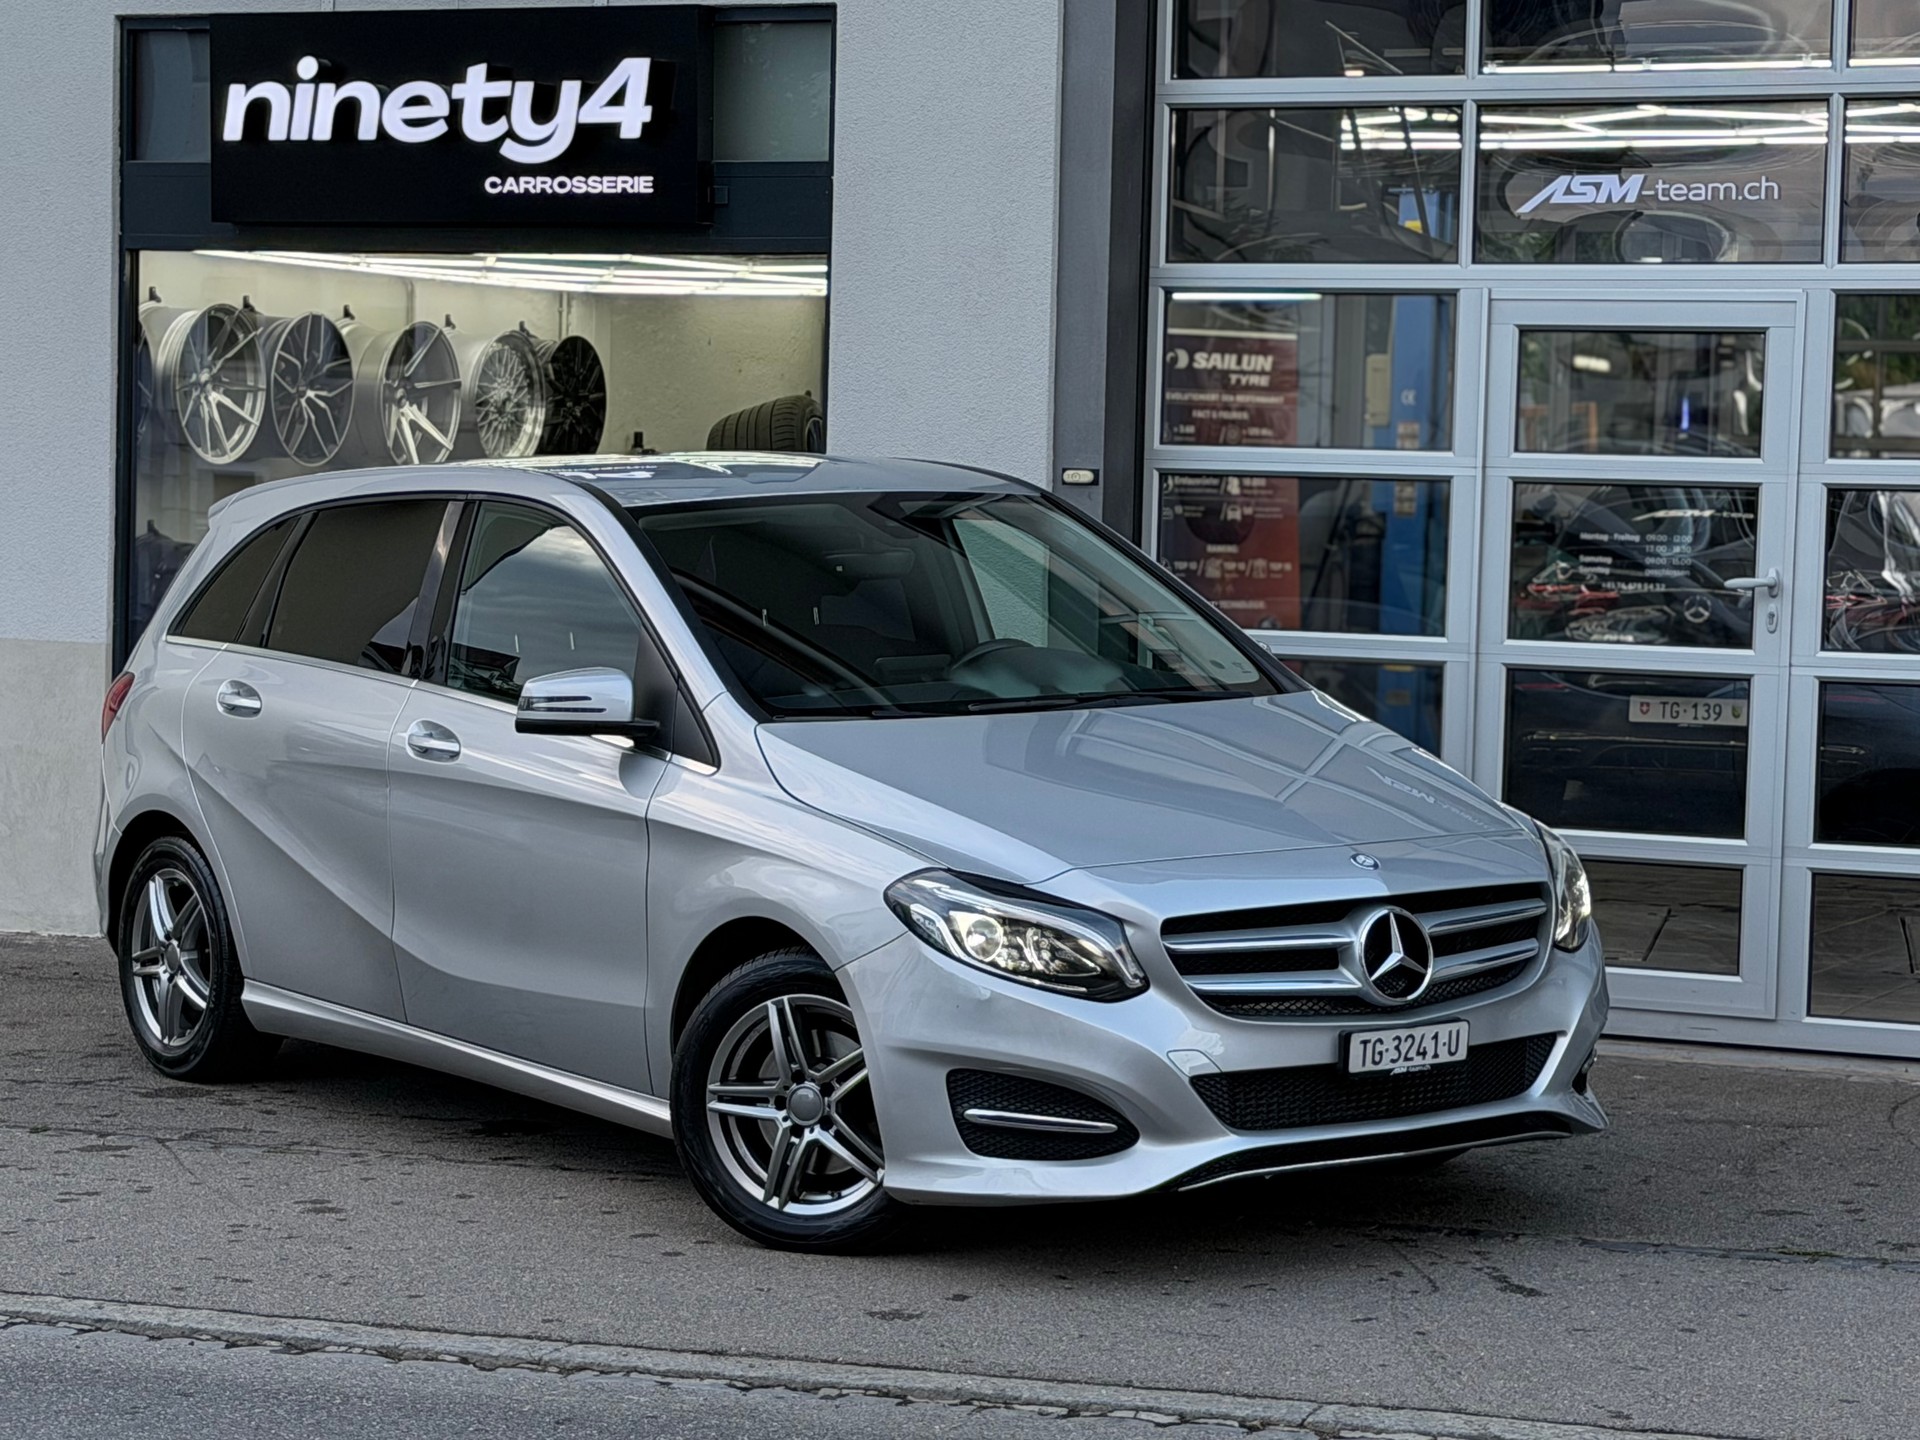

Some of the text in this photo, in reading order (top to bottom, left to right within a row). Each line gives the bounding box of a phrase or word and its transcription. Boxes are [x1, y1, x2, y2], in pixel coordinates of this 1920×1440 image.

[223, 56, 652, 163] ninety4
[485, 176, 653, 194] CARROSSERIE
[1516, 173, 1779, 213] ASM-team.ch
[1193, 352, 1274, 372] SAILUN
[1228, 373, 1271, 387] TYRE
